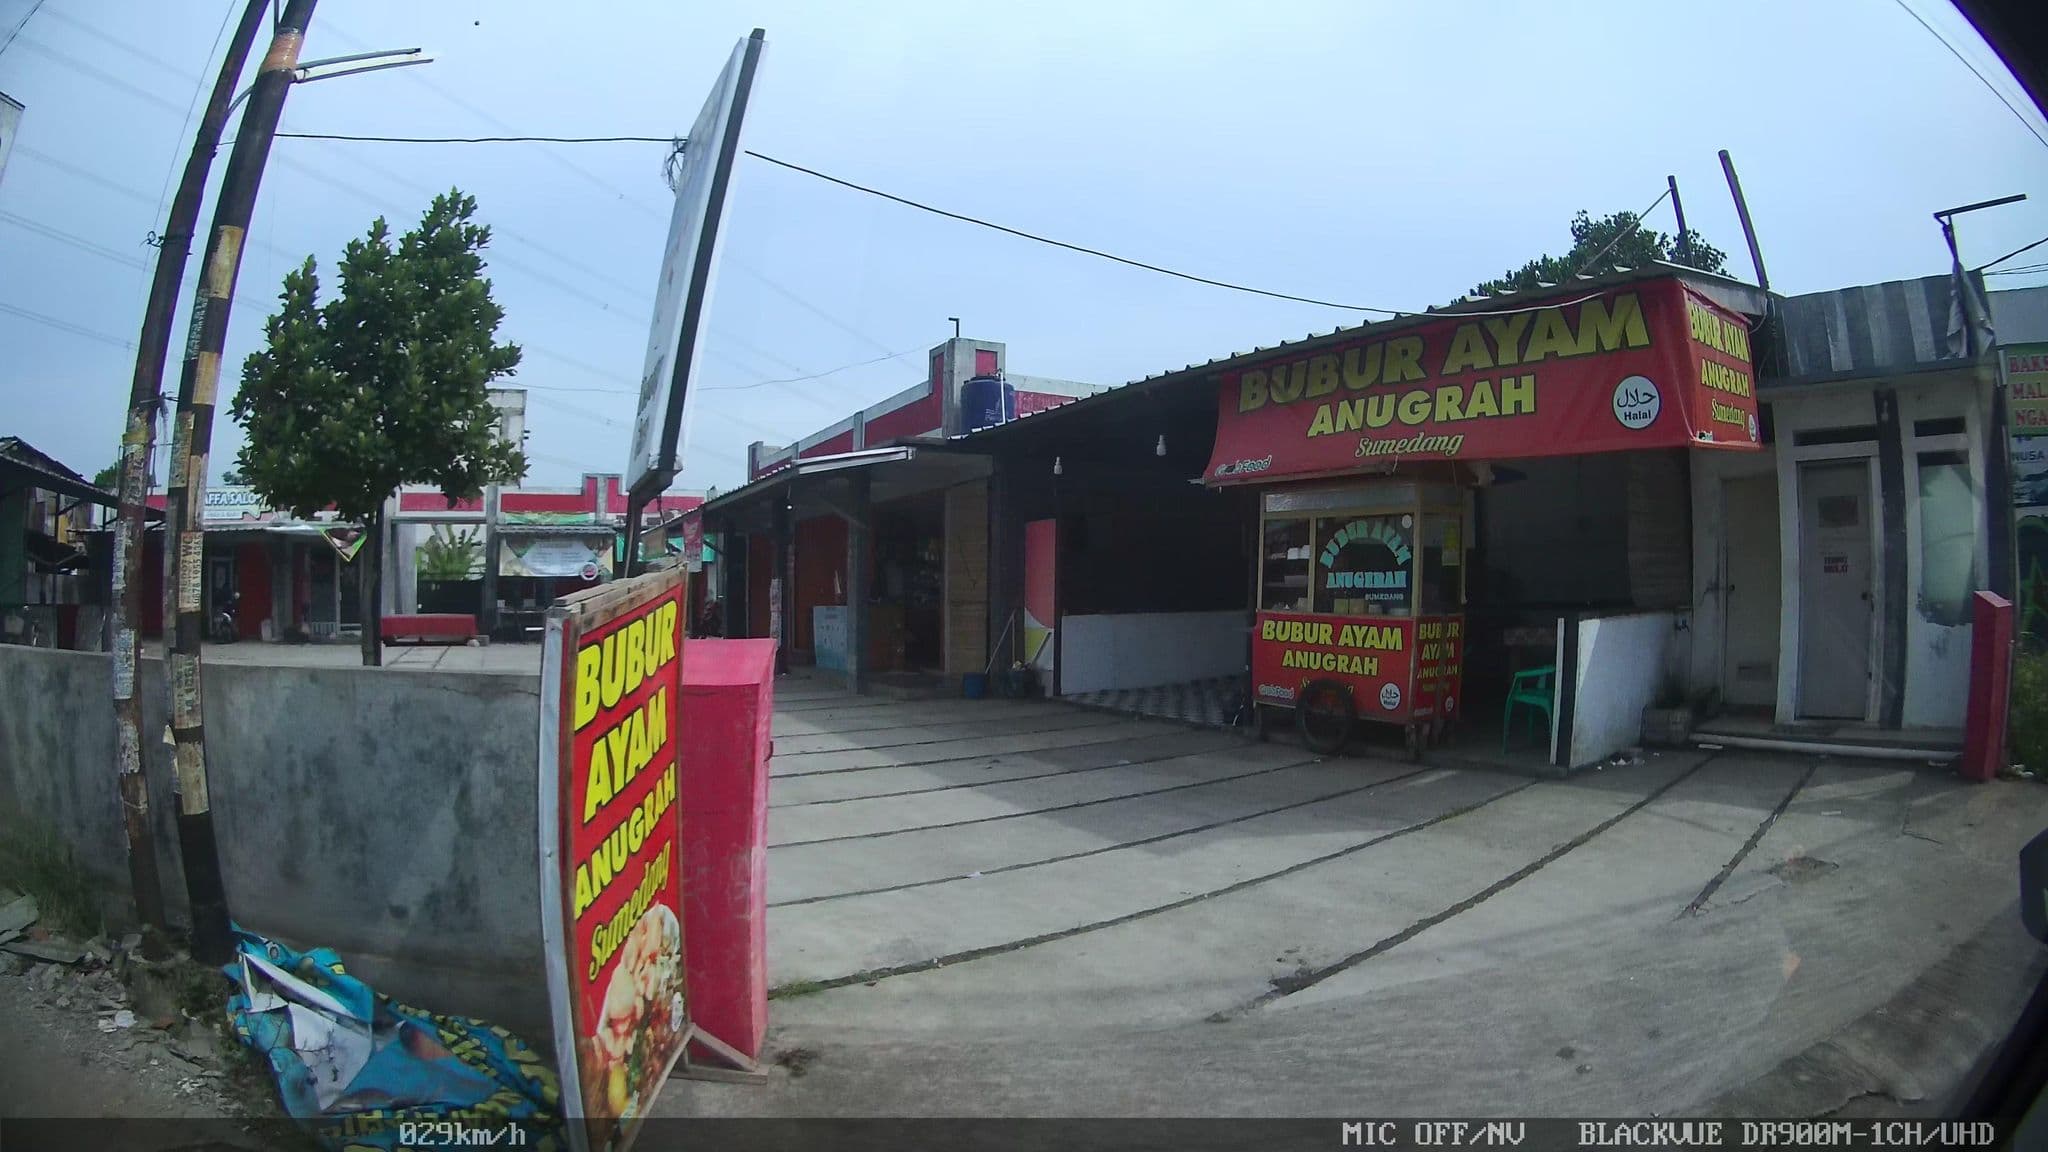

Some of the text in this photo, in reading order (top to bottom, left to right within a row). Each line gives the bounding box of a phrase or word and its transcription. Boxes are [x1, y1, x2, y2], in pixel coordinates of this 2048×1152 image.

[1239, 293, 1650, 413] BUBUR AYAM
[1688, 301, 1750, 363] BUBUR AYAM
[1307, 374, 1536, 438] ANUGRAH
[1617, 387, 1657, 408] حلال
[1624, 409, 1652, 421] Halal
[1712, 399, 1746, 431] Sumedang
[1355, 432, 1465, 458] Sumedang
[1319, 520, 1369, 569] BUBUR
[1262, 619, 1404, 651] BUBUR AYAM
[574, 600, 677, 732] BUBUR
[1282, 650, 1379, 676] ANUGRAH
[583, 686, 667, 825] AYAM
[574, 762, 677, 920] ANUGRAH
[588, 840, 671, 982] Sumedang
